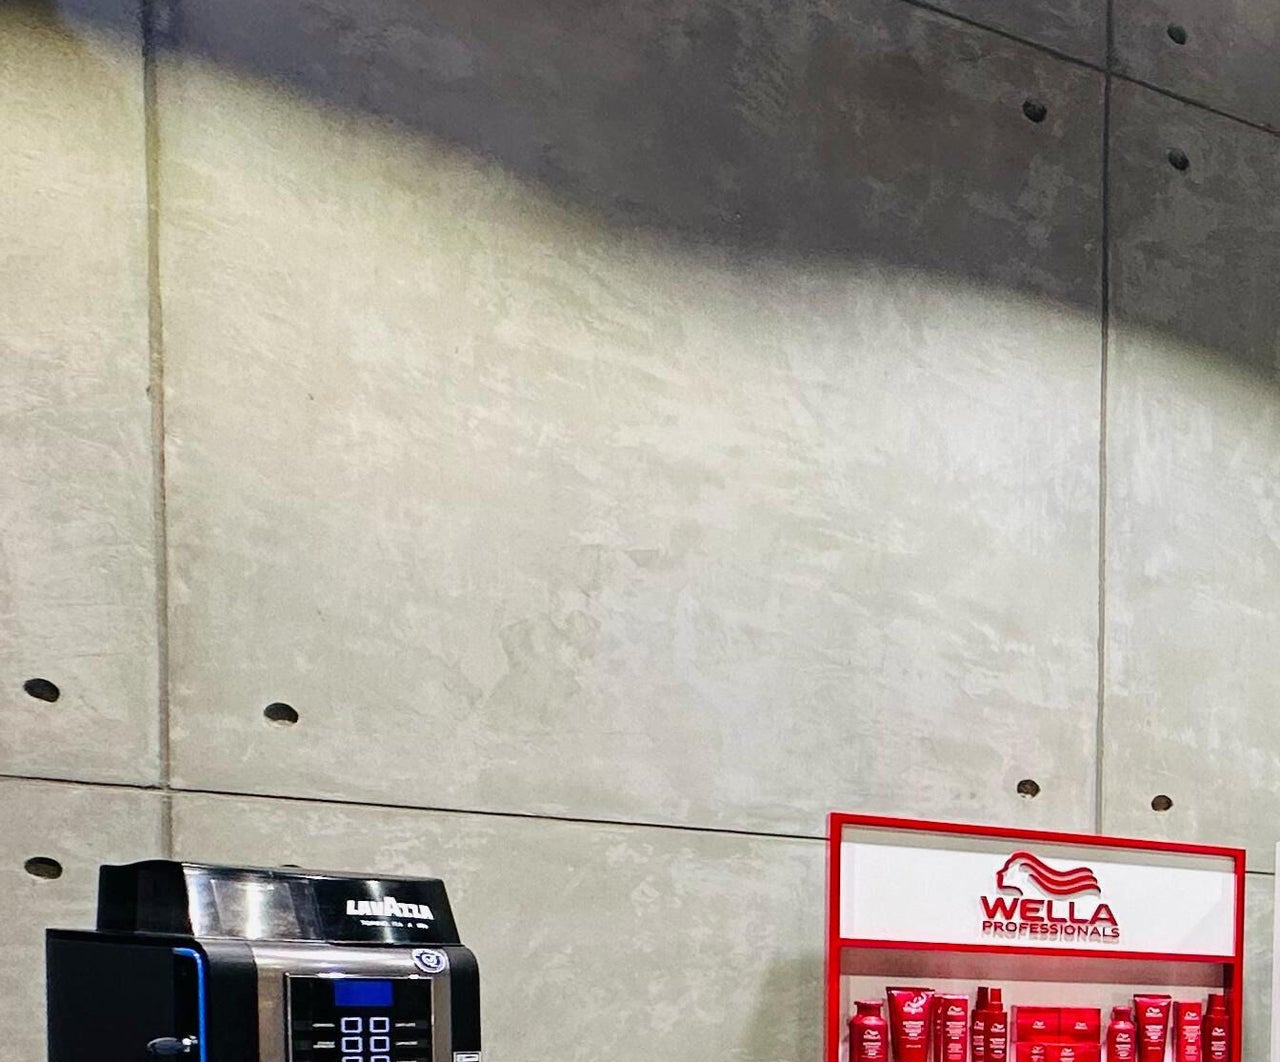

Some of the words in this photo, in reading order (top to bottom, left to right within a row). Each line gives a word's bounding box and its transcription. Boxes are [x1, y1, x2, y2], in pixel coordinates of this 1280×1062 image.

[346, 896, 435, 920] LAVAZZA
[980, 895, 1119, 926] WELLA
[982, 920, 1120, 938] PROFESSIONALS
